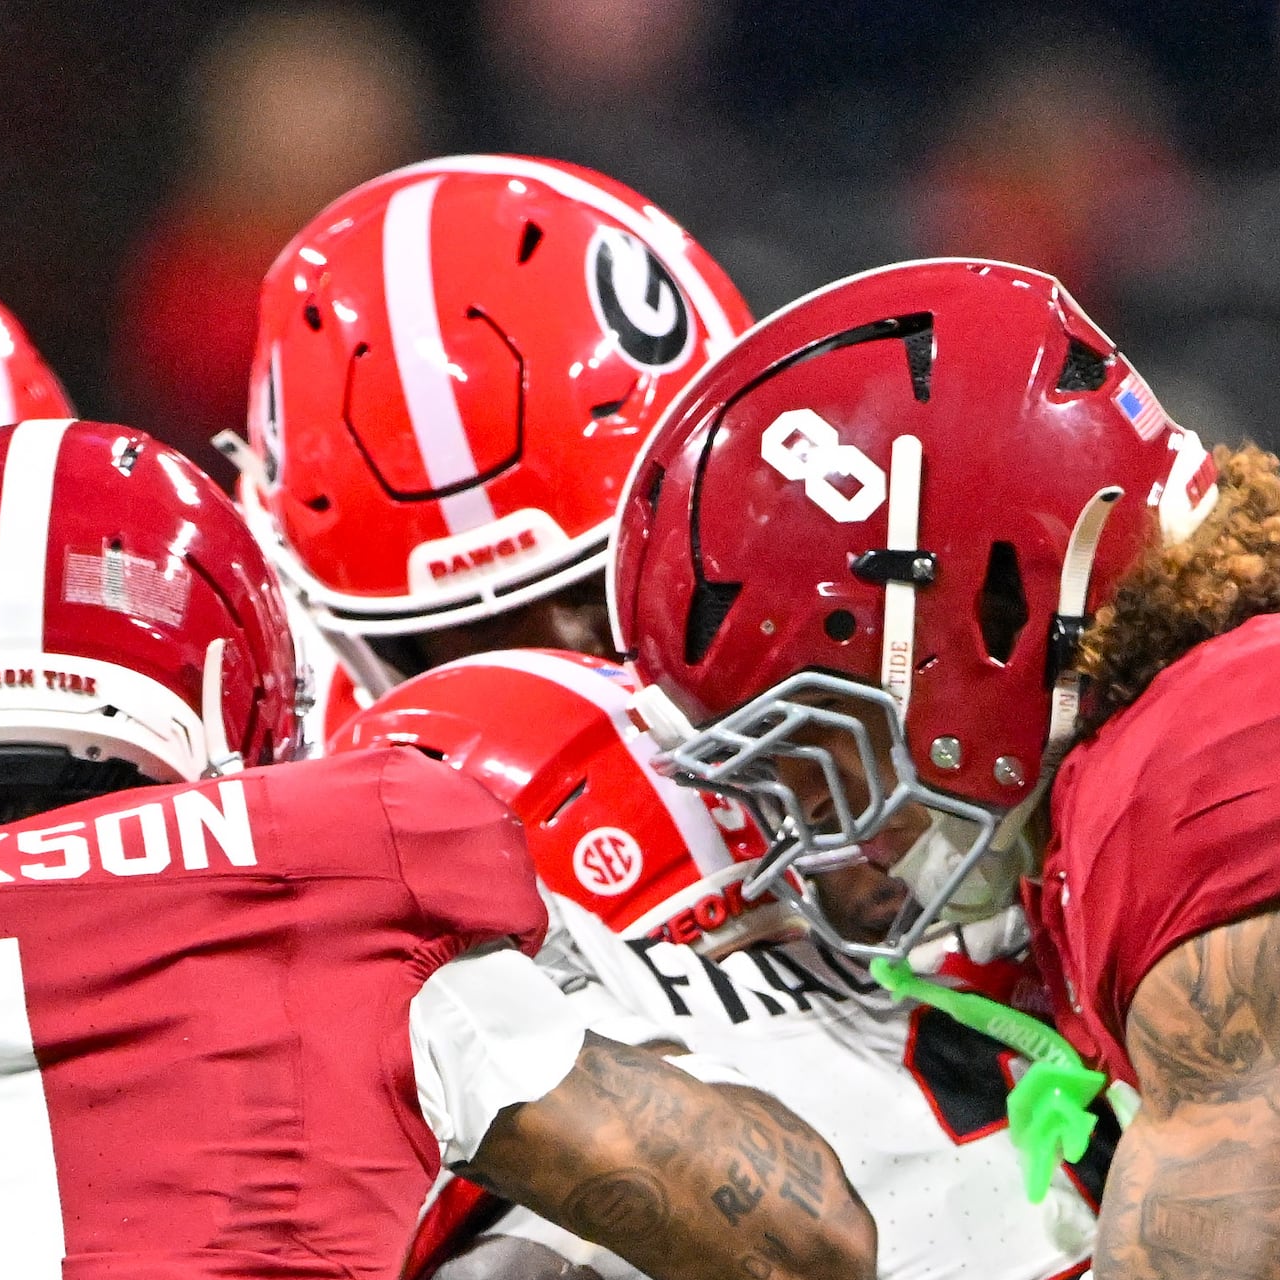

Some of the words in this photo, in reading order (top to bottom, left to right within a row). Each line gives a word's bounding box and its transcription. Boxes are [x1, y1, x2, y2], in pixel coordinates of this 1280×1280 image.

[595, 235, 688, 366] G
[761, 408, 887, 523] 8
[429, 529, 536, 578] DAWGS
[43, 670, 96, 696] TIDE
[890, 640, 909, 688] TIDE
[584, 836, 632, 885] SEC
